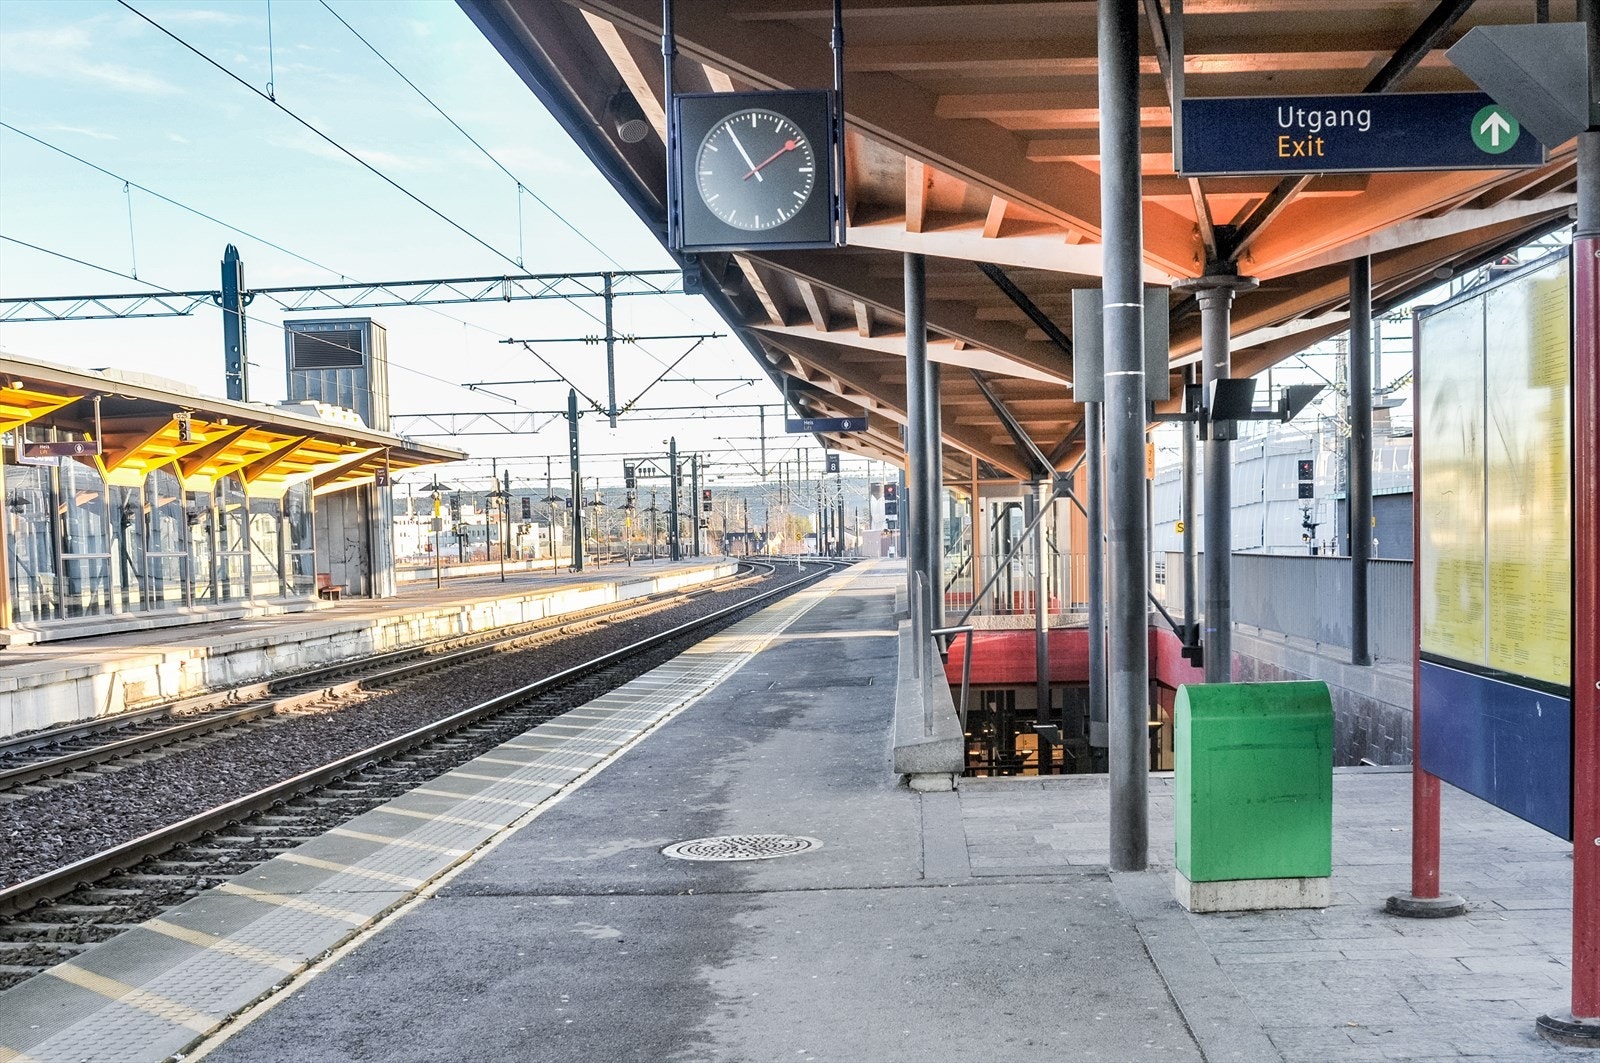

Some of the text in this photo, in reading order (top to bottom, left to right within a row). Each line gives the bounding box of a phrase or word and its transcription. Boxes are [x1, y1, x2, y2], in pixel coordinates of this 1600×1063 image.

[1278, 106, 1371, 132] Utgang
[1278, 135, 1325, 157] Exit
[830, 463, 836, 471] 8
[379, 476, 384, 485] 7
[1177, 522, 1184, 533] S
[796, 533, 801, 541] S
